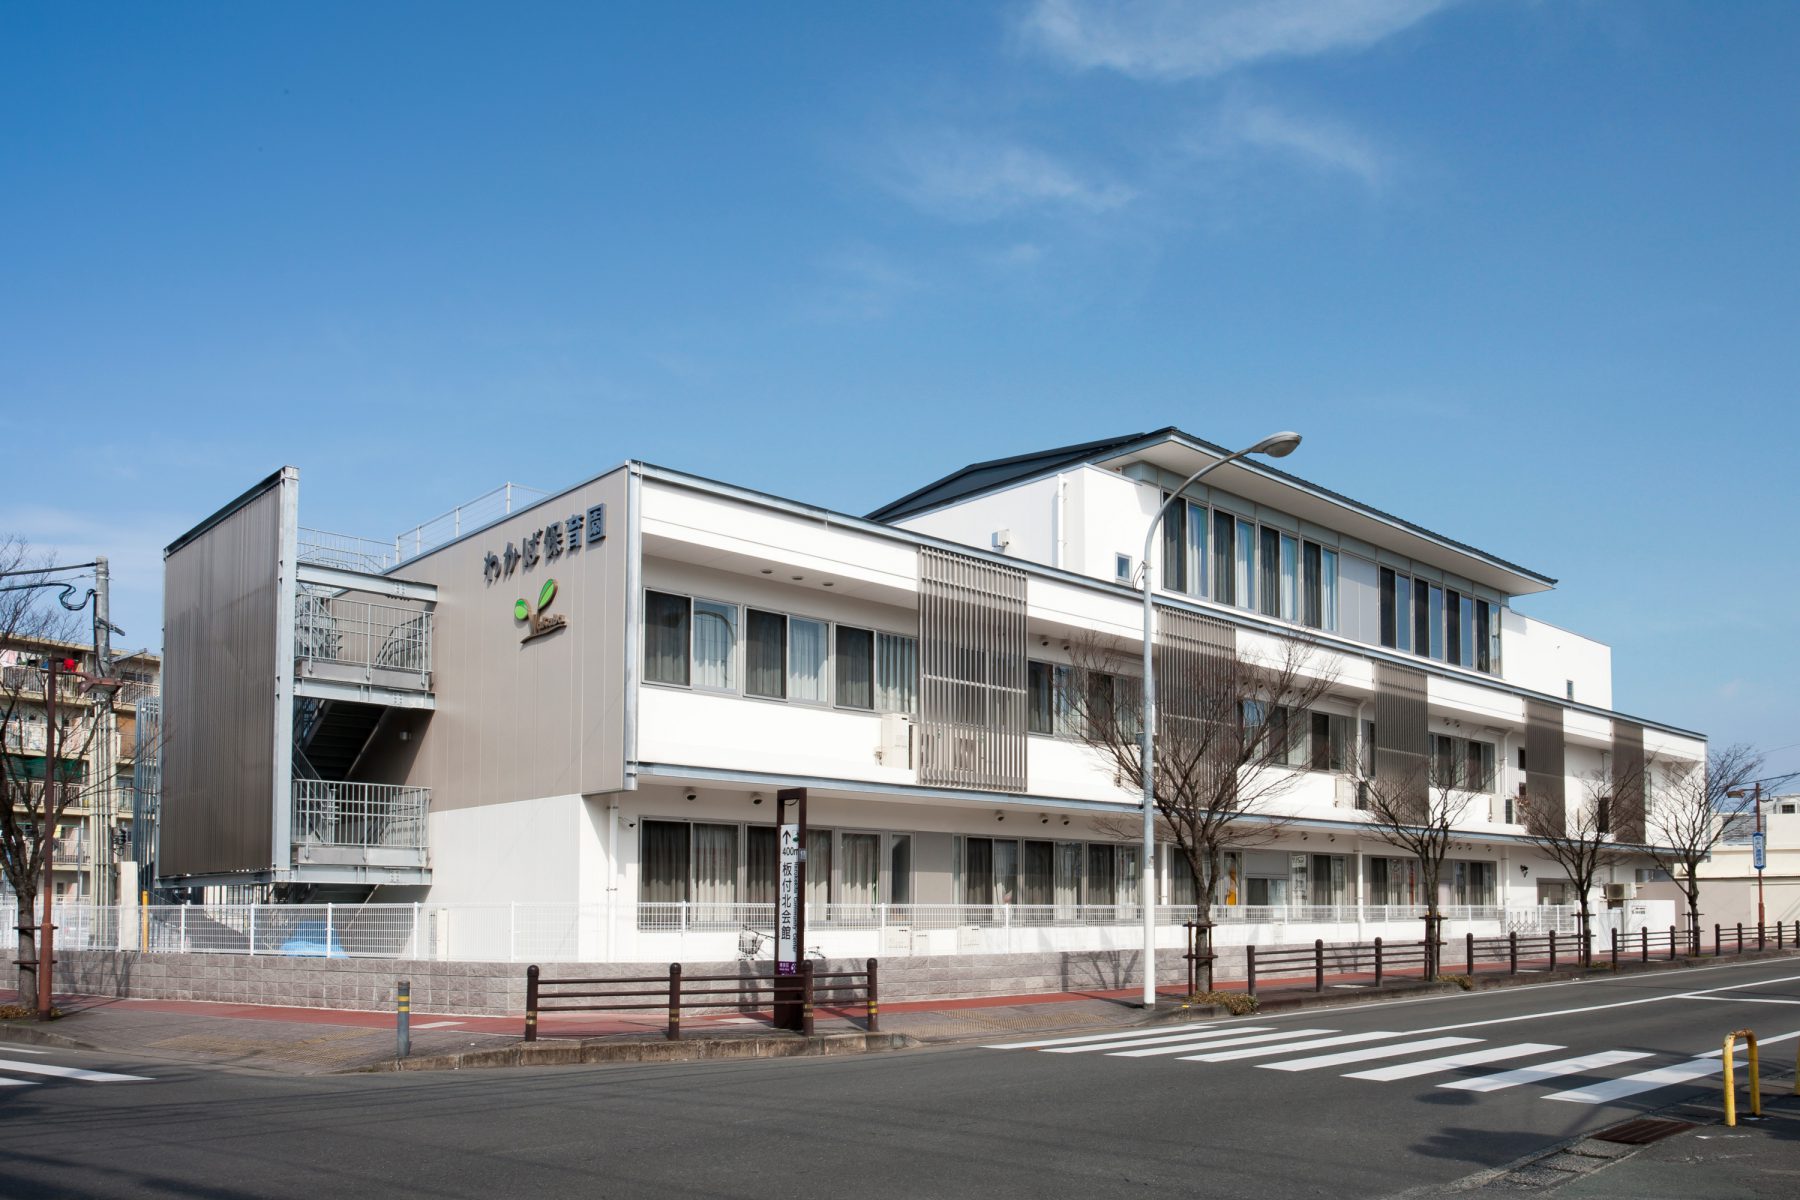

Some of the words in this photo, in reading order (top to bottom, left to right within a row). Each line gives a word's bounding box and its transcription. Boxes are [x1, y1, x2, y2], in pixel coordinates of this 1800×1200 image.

[483, 503, 606, 582] わかば保育園
[782, 847, 799, 856] 400m
[781, 862, 792, 940] 板付北会館
